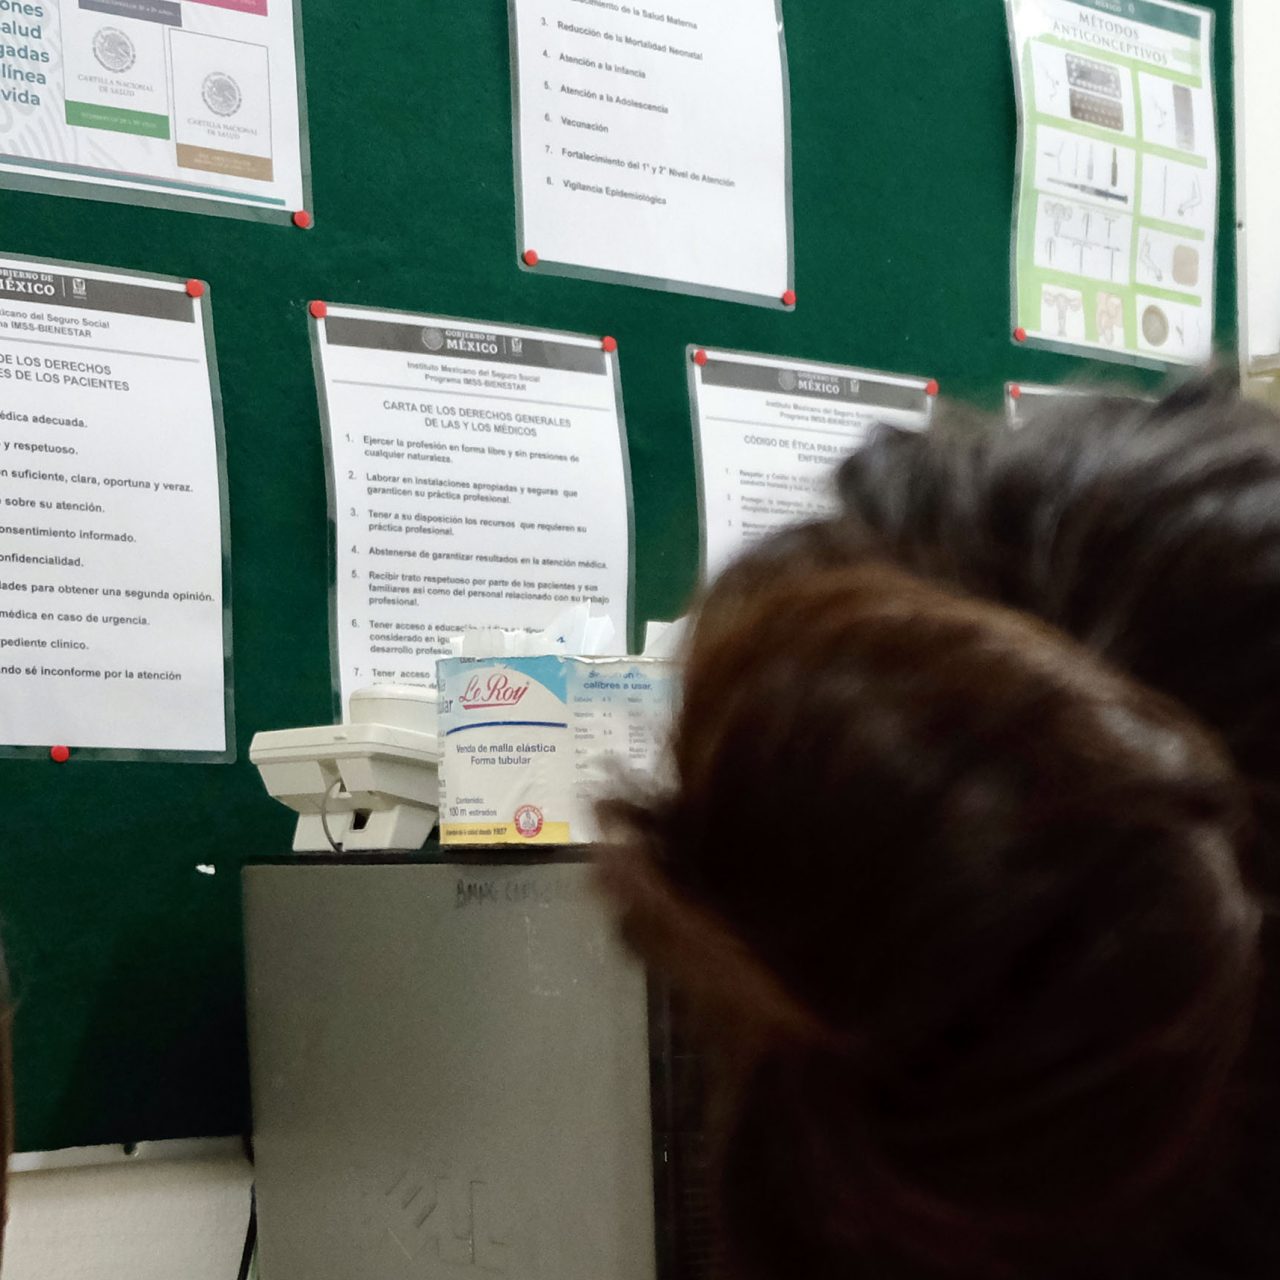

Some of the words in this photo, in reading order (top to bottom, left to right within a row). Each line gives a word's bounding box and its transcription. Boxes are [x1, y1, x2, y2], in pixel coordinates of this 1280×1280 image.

[0, 0, 43, 17] ones
[642, 10, 665, 22] Salud
[666, 15, 698, 30] Materna
[0, 21, 41, 39] alud
[604, 31, 613, 41] de
[625, 35, 666, 53] Mortalidad
[669, 46, 702, 60] Neonatal
[1053, 21, 1167, 65] ANTICONCEPTIVOS
[559, 53, 596, 69] Atención
[2, 63, 46, 84] línea
[1, 88, 40, 105] vida
[560, 84, 597, 100] Atención
[615, 96, 668, 114] Adolescencia
[561, 116, 609, 133] Vacunación
[562, 148, 625, 168] Fortalecimiento
[627, 160, 640, 170] del
[669, 168, 688, 179] Nivel
[701, 174, 735, 188] Atención
[563, 180, 603, 194] Vigilancia
[605, 186, 667, 205] Epidemiológica
[30, 312, 44, 320] del
[47, 314, 79, 325] Seguro
[82, 318, 109, 328] Social
[11, 321, 92, 338] IMSS-BIENESTAR
[446, 337, 498, 354] MÉXICO
[17, 355, 41, 368] LOS
[45, 358, 111, 375] DERECHOS
[15, 370, 32, 381] DE
[36, 372, 60, 384] LOS
[64, 375, 130, 391] PACIENTES
[32, 414, 88, 427] adecuada.
[383, 400, 417, 412] CARTA
[420, 404, 433, 414] DE
[436, 405, 456, 416] LOS
[460, 407, 513, 422] DERECHOS
[515, 412, 571, 428] GENERALES
[425, 417, 438, 427] DE
[441, 419, 461, 430] LAS
[472, 422, 491, 433] LOS
[14, 442, 78, 455] respetuoso.
[12, 469, 68, 483] suficiente,
[71, 474, 101, 486] clara,
[104, 477, 151, 489] oportuna
[163, 482, 194, 492] veraz.
[366, 473, 400, 484] Laborar
[403, 476, 413, 484] en
[473, 482, 518, 494] apropiadas
[5, 497, 36, 508] sobre
[39, 501, 52, 509] su
[56, 501, 105, 513] atención.
[368, 510, 392, 520] Tener
[465, 516, 477, 525] los
[480, 519, 515, 529] recursos
[80, 530, 137, 543] informado.
[369, 546, 417, 558] Abstenerse
[476, 553, 518, 564] resultados
[0, 581, 27, 592] ades
[31, 584, 55, 594] para
[58, 585, 99, 596] obtener
[103, 588, 121, 597] una
[125, 590, 170, 601] segunda
[173, 592, 215, 602] opinión.
[468, 588, 503, 600] personal
[41, 613, 54, 621] en
[57, 612, 83, 623] caso
[86, 614, 98, 623] de
[102, 615, 150, 626] urgencia.
[41, 666, 101, 678] inconforme
[104, 671, 122, 680] por
[125, 670, 134, 679] la
[137, 671, 182, 681] atención
[584, 681, 620, 689] calibres
[456, 744, 476, 752] Venda
[478, 744, 487, 752] de
[490, 744, 513, 752] malla
[471, 756, 496, 765] Forma
[499, 756, 531, 765] tubular
